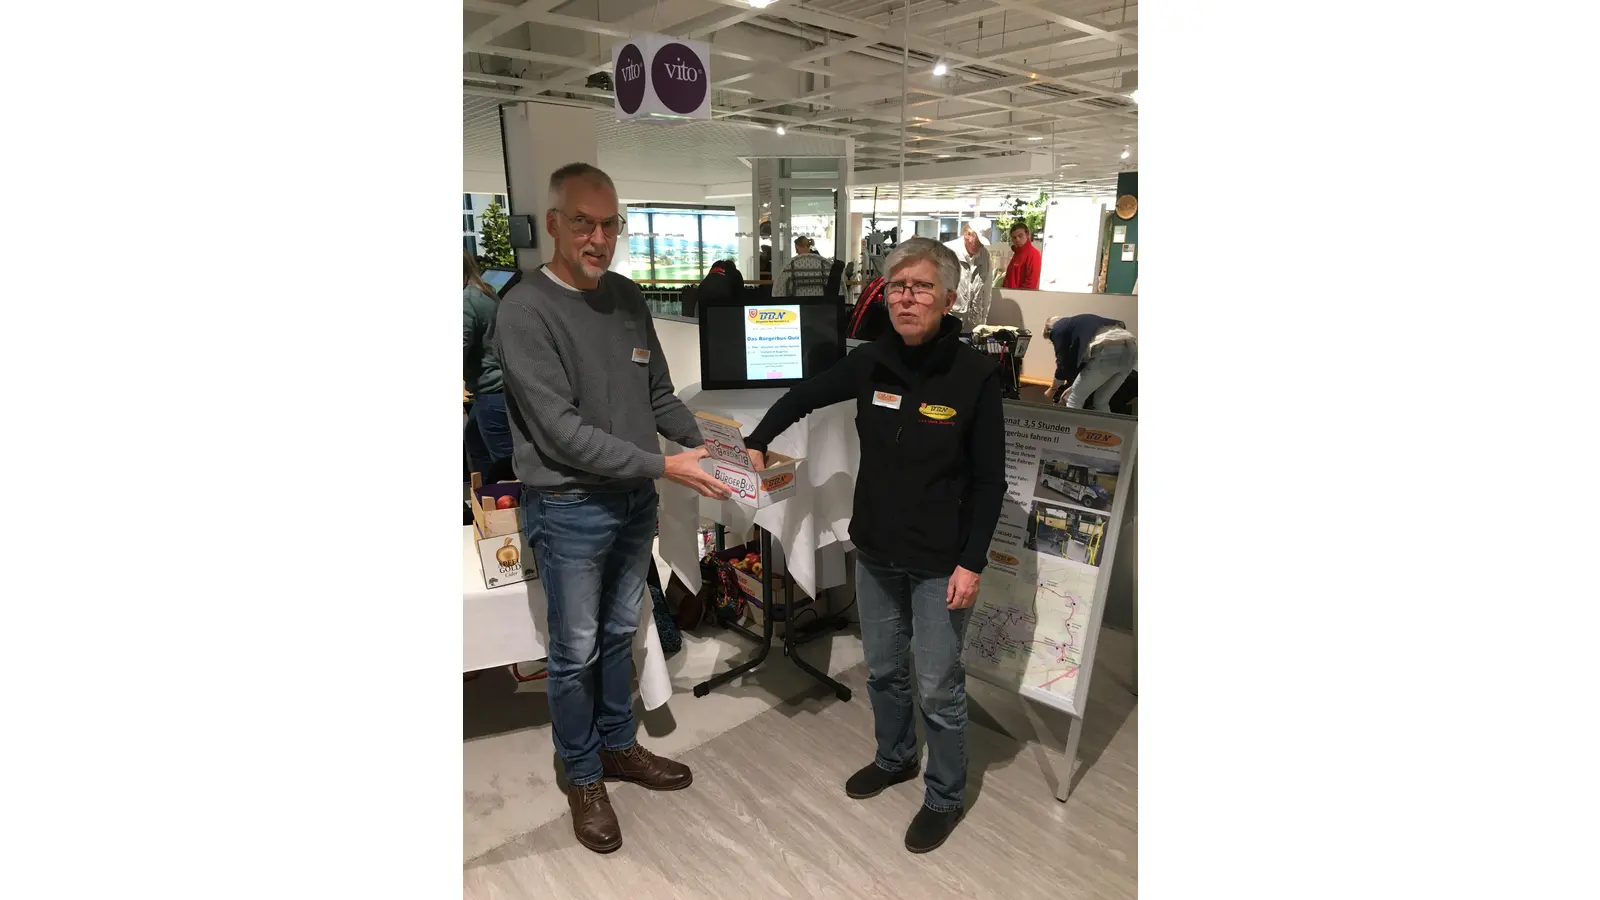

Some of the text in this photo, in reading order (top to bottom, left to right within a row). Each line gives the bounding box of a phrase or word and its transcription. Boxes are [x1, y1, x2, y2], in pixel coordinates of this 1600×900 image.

[621, 58, 641, 82] vito
[664, 57, 698, 82] vito
[1004, 417, 1071, 434] onat 3,5 Stunden
[1004, 430, 1029, 440] rgerbus
[1030, 432, 1052, 443] fahren
[499, 563, 522, 574] GOLD
